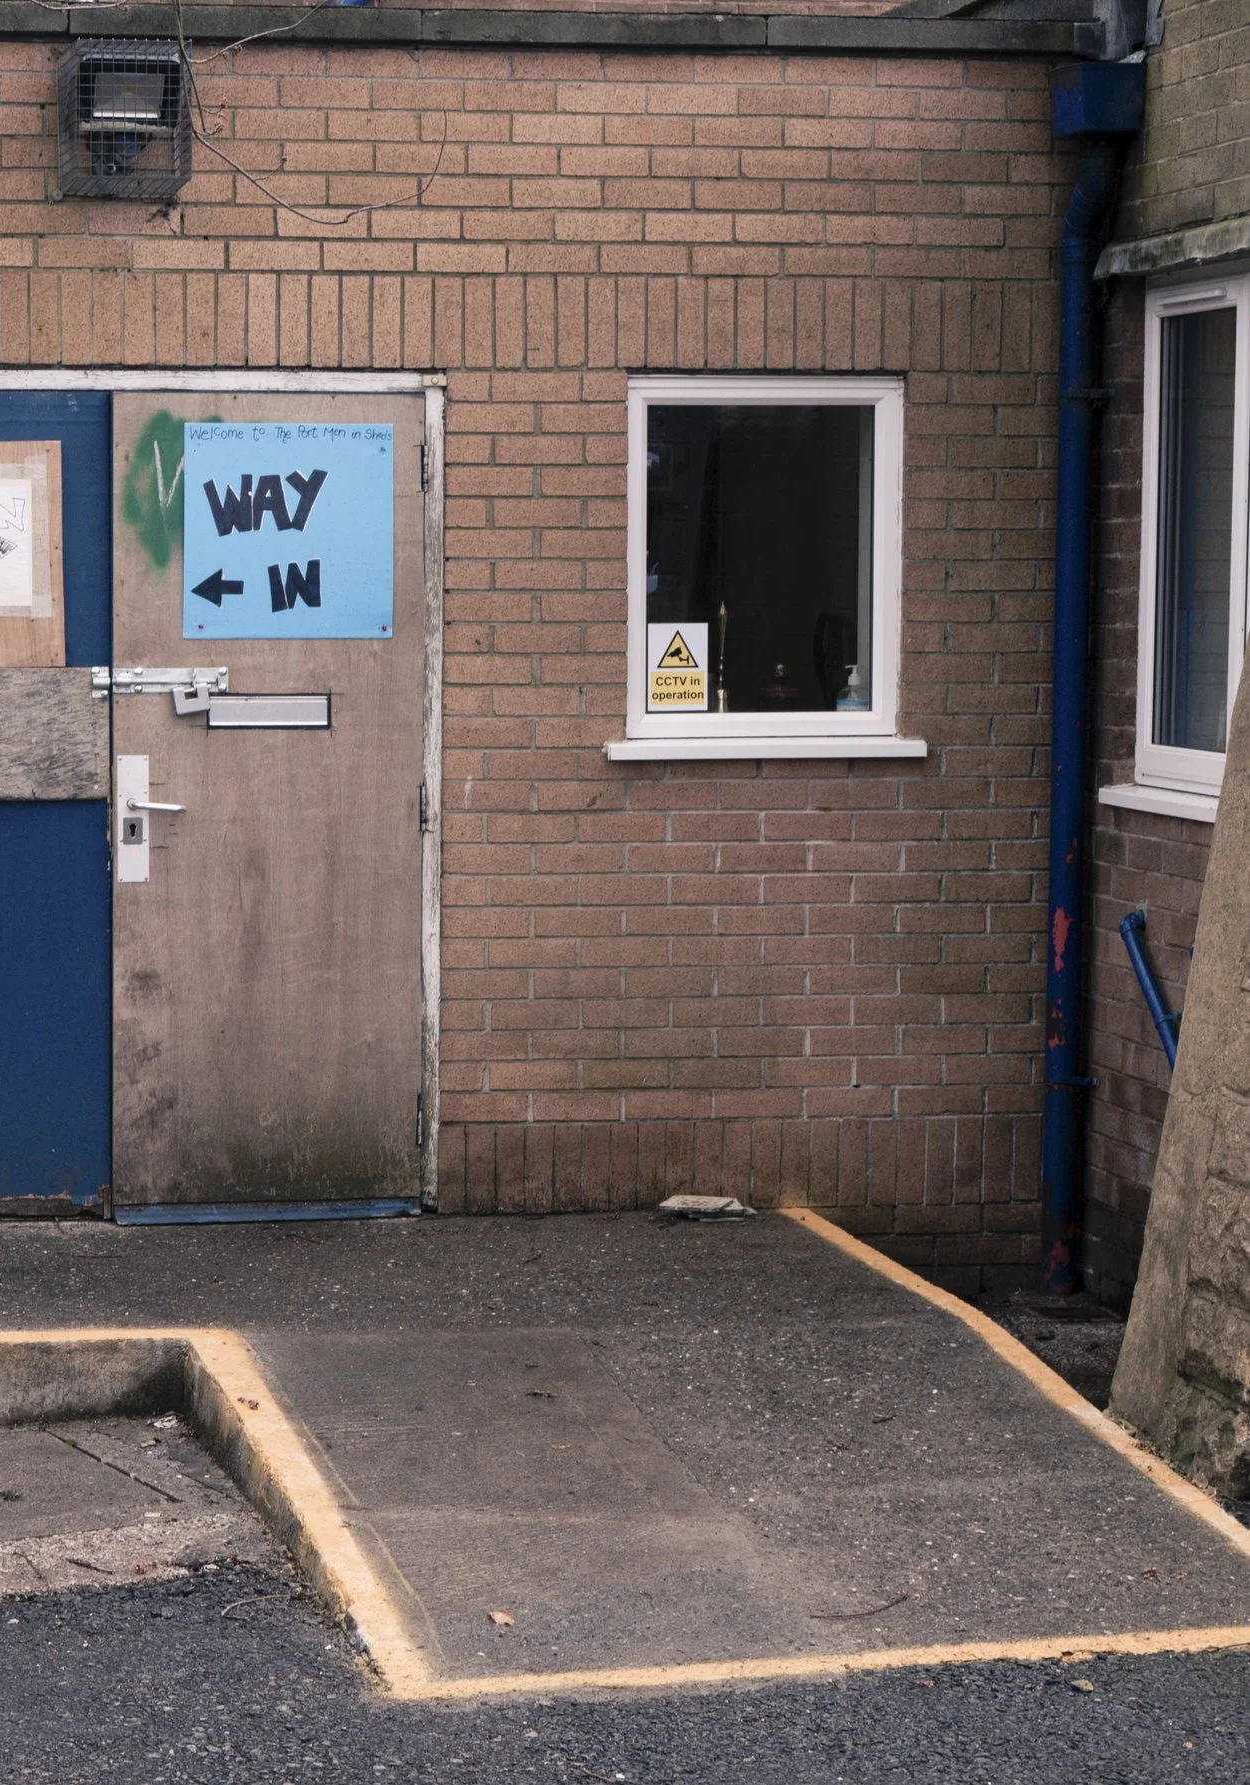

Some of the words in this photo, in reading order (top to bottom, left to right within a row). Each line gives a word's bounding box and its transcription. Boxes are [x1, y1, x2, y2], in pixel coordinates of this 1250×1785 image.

[189, 425, 244, 441] Welcome
[252, 426, 266, 442] to
[274, 425, 292, 445] The
[297, 424, 319, 440] Port
[323, 427, 346, 443] Men
[351, 430, 362, 440] in
[203, 469, 329, 537] WAY
[267, 558, 322, 613] IN
[655, 676, 687, 686] CCTV
[690, 676, 700, 686] in
[652, 689, 704, 701] operation
